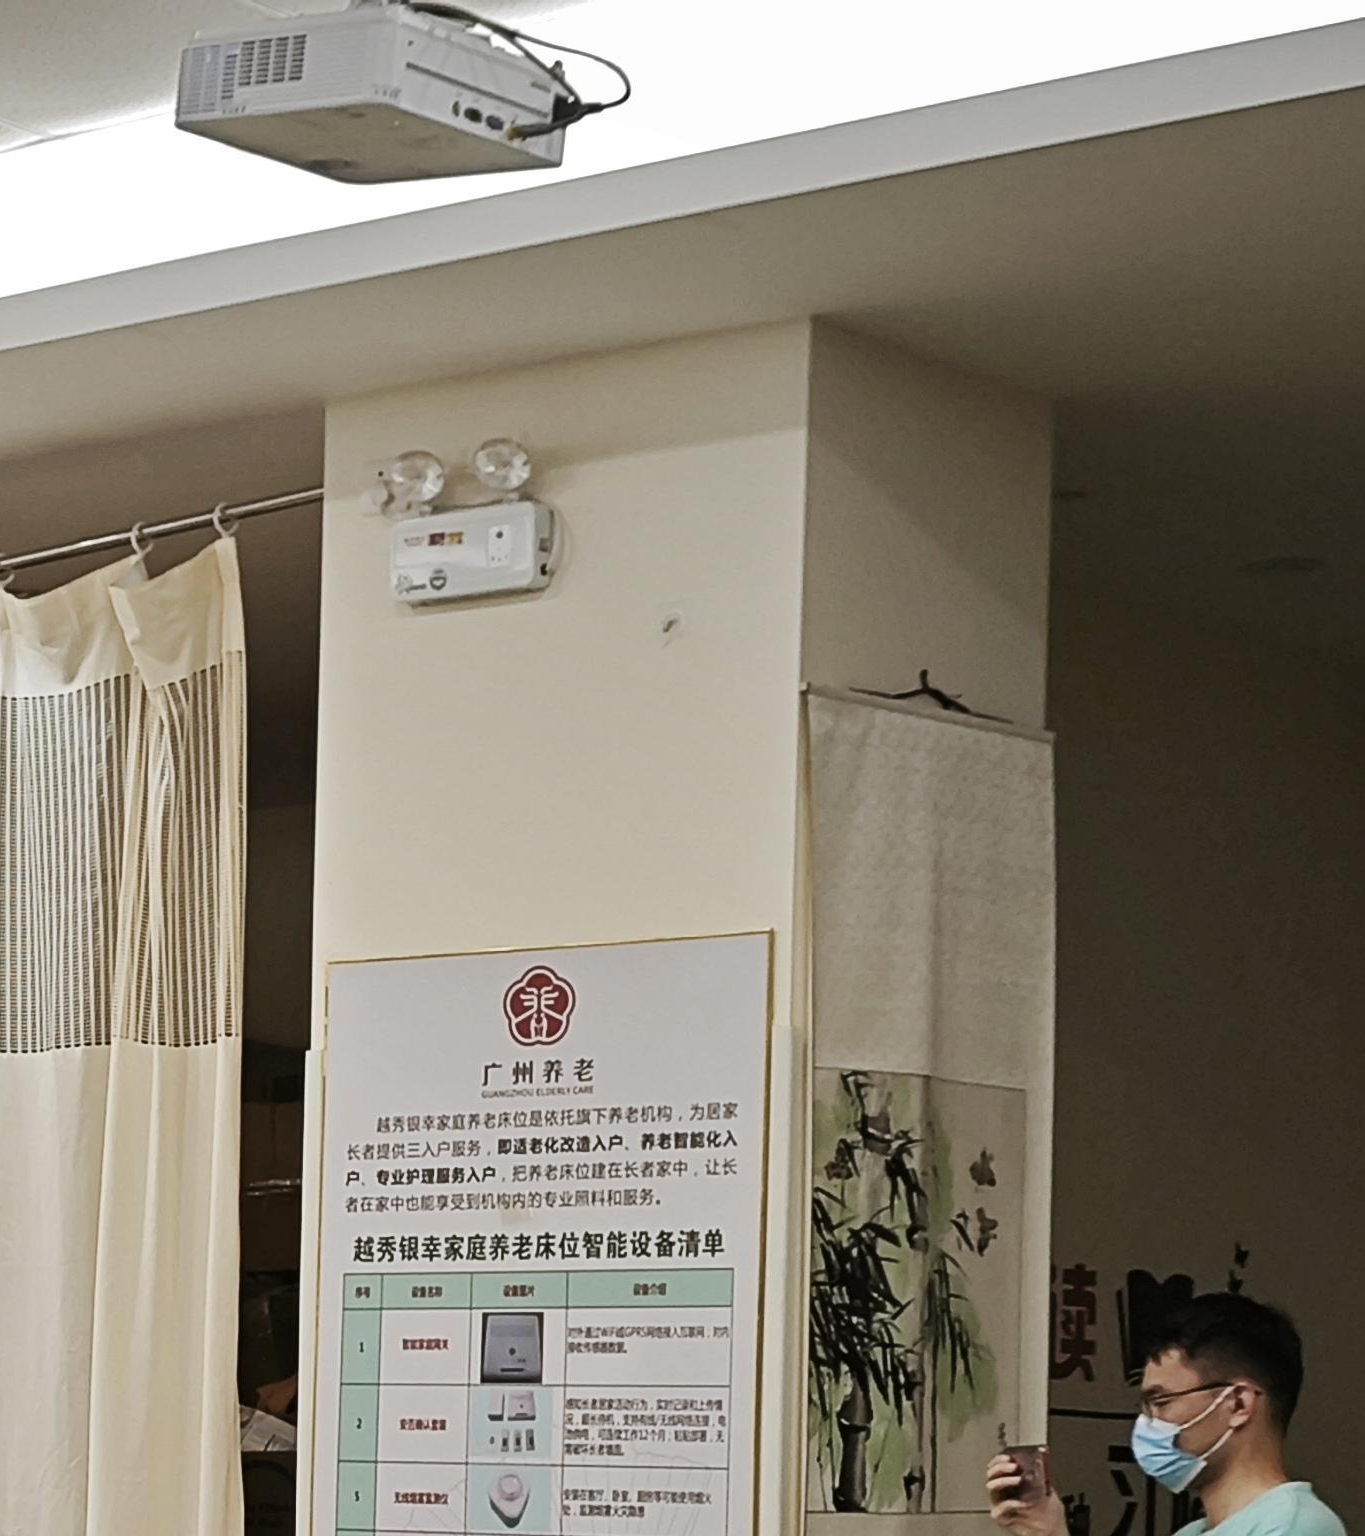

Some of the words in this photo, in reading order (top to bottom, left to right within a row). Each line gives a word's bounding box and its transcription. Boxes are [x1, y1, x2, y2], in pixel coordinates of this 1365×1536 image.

[481, 1058, 595, 1086] 广州养老
[572, 1085, 594, 1095] CARE
[353, 1228, 725, 1262] 越秀银幸家庭养老床位智能设备清单
[359, 1342, 364, 1353] 1
[356, 1417, 362, 1429] 2
